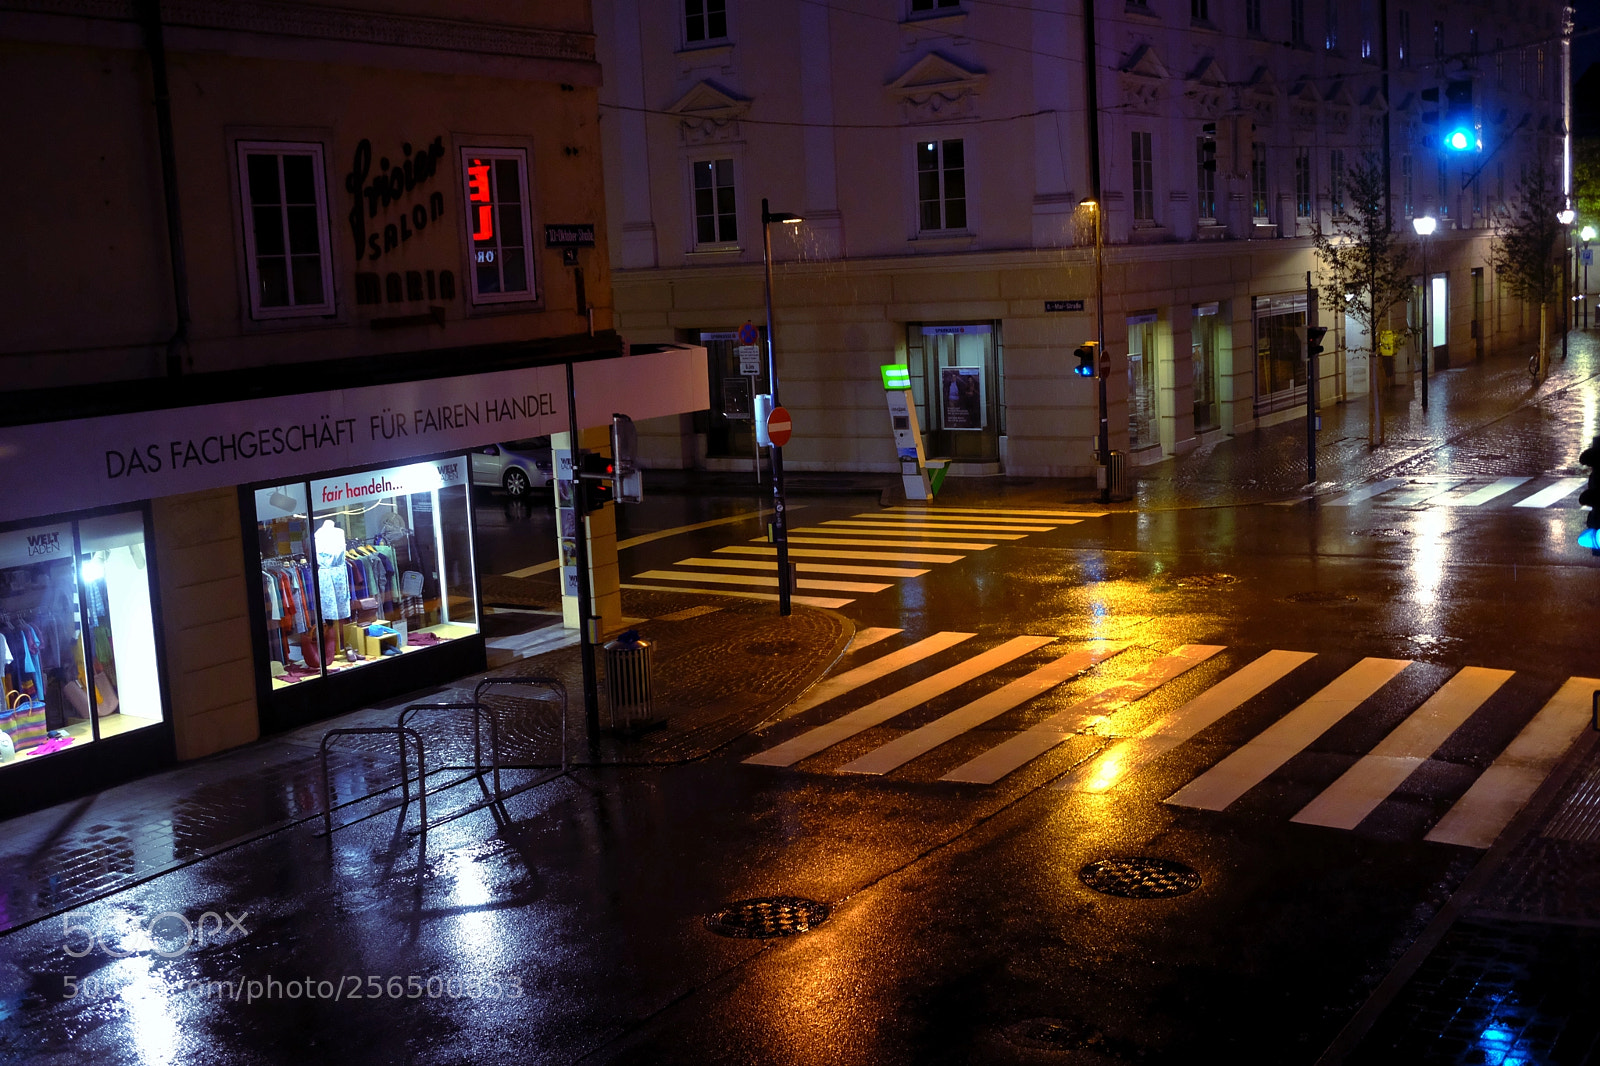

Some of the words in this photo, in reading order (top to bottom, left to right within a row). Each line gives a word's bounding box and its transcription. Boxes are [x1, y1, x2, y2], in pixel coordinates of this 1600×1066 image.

[369, 191, 444, 260] SALON
[355, 270, 455, 304] MARIA
[105, 444, 163, 479] DAS
[170, 414, 357, 470] FACHGESCHÄFT
[370, 409, 408, 440] FÜR
[414, 402, 480, 435] FAIREN
[485, 392, 558, 424] HANDEL
[437, 463, 458, 475] WELT
[322, 485, 343, 503] fair
[26, 531, 60, 546] WELT
[27, 542, 60, 557] LADEN
